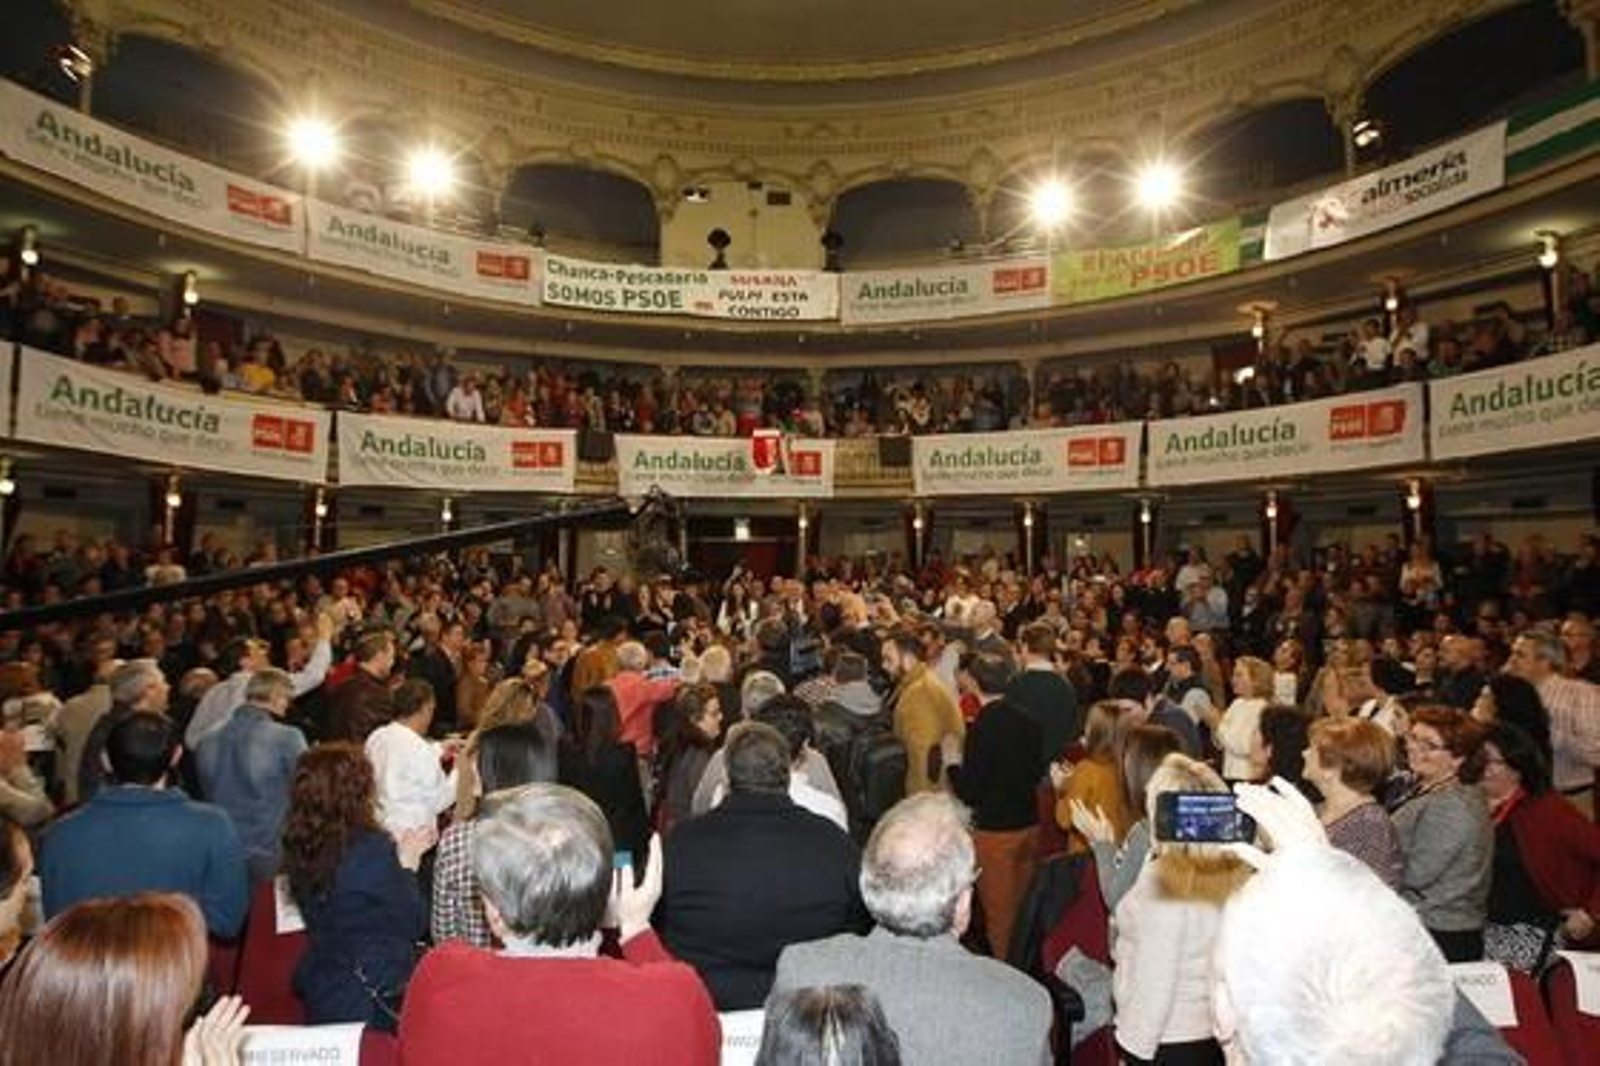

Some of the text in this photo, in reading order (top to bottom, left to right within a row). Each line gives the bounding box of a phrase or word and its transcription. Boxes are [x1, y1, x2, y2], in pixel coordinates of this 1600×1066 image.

[1131, 250, 1219, 288] PSOE
[547, 282, 617, 307] SOMOS
[622, 289, 684, 309] PSOE
[728, 304, 800, 318] CONTIGO
[50, 374, 222, 434] Andalucía
[1451, 360, 1600, 417] Andalucía
[360, 429, 487, 462] Andalucía
[1164, 416, 1297, 454] Andalucía
[635, 450, 747, 472] Andalucía
[930, 443, 1041, 468] Andalucía
